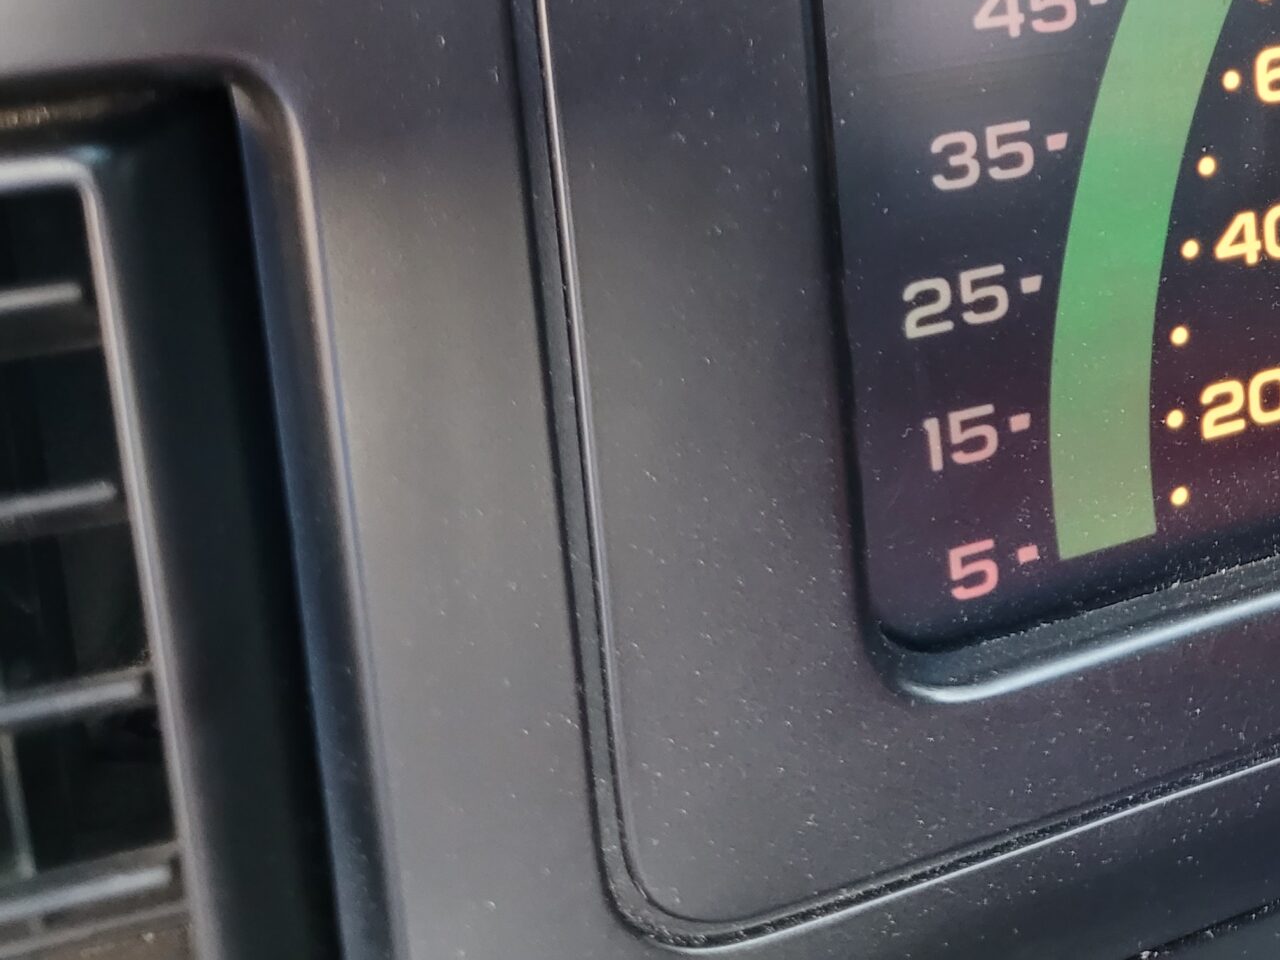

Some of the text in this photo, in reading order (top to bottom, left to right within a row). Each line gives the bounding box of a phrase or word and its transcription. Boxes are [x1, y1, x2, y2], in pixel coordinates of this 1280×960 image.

[930, 120, 1034, 191] 35
[902, 265, 1010, 340] 25
[923, 404, 999, 471] 15
[948, 539, 999, 601] 5
